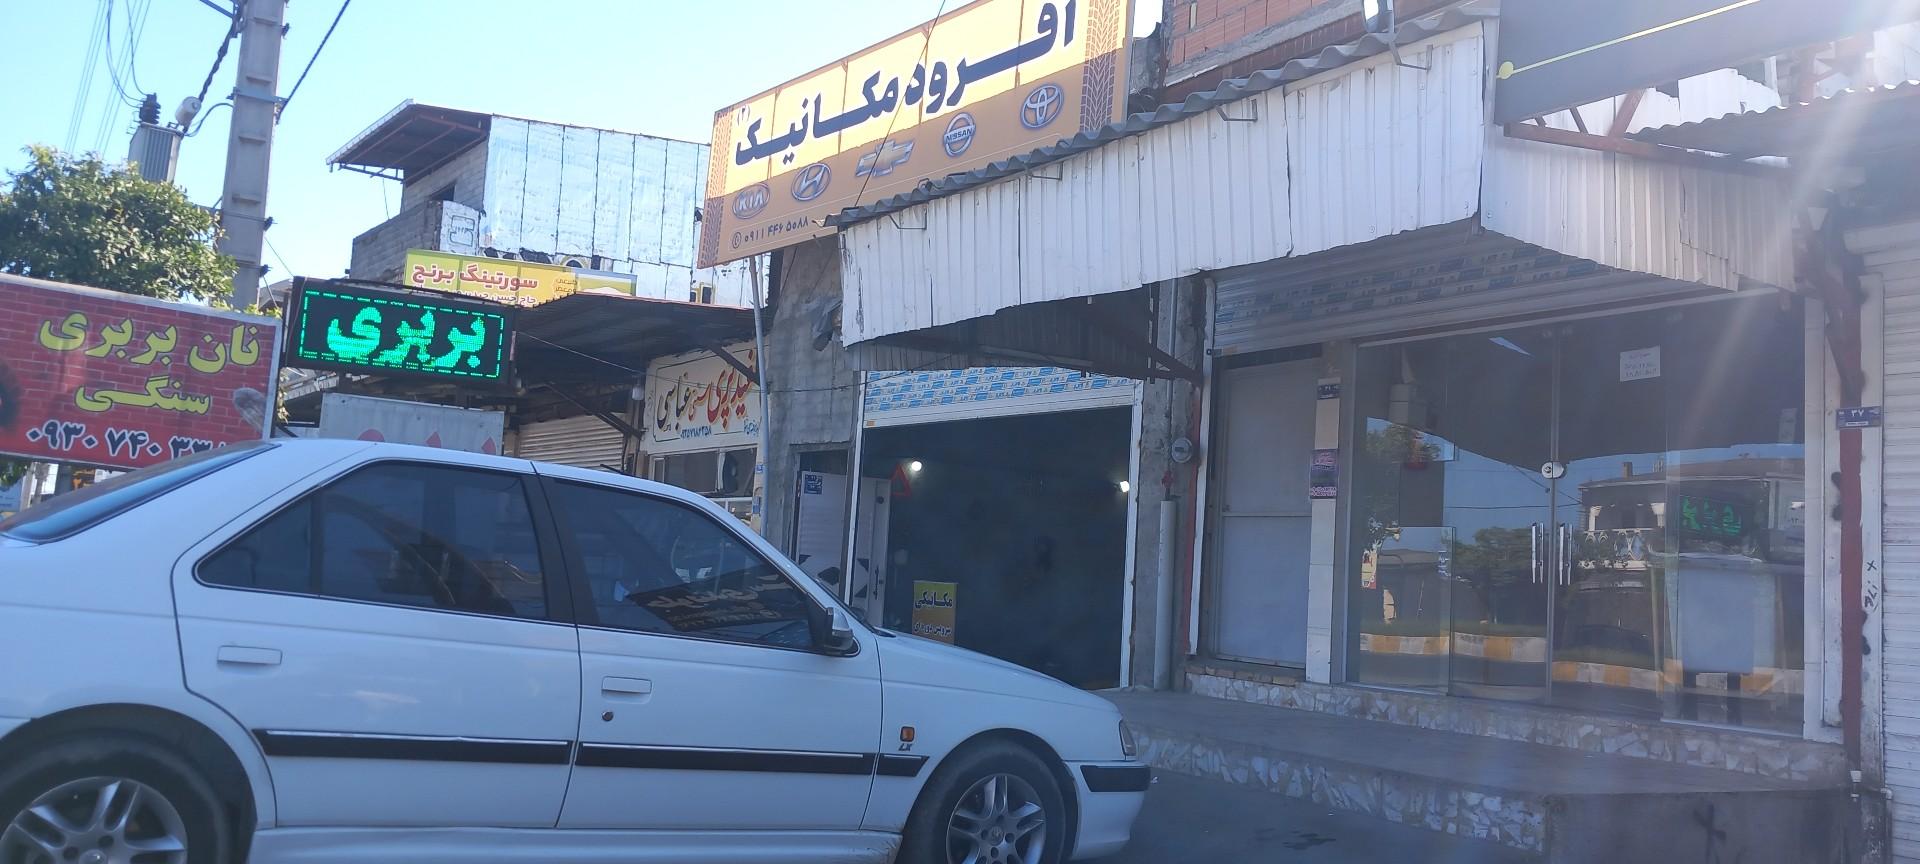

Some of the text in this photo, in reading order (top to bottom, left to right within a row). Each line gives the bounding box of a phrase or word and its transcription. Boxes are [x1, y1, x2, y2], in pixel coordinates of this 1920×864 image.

[735, 70, 900, 166] مکانیک
[38, 311, 260, 374] نان بربری
[327, 306, 486, 368] بربری
[74, 375, 212, 416] سنگی
[26, 419, 97, 451] ۰۹۳۰
